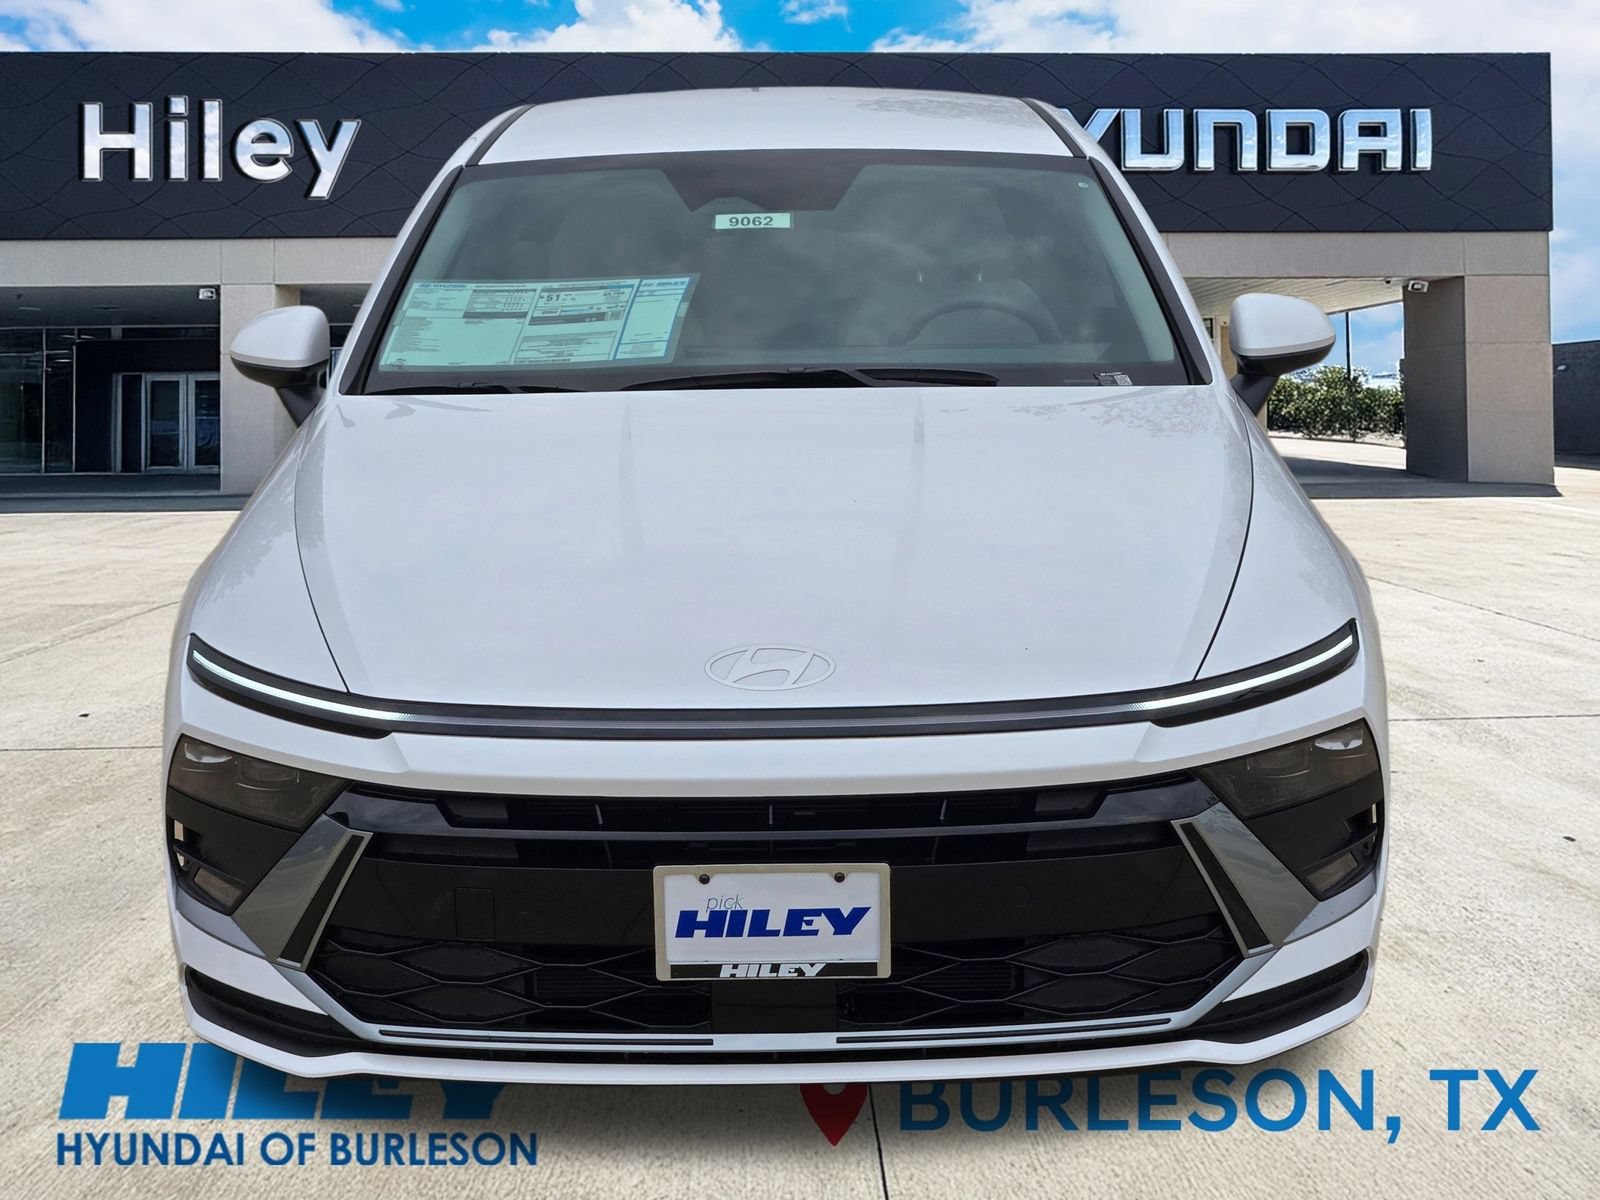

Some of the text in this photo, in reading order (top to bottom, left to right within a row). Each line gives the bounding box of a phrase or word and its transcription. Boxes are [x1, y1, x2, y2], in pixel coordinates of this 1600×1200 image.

[80, 95, 361, 199] Hiley
[728, 215, 774, 227] 9062
[706, 894, 745, 913] pick
[675, 907, 872, 938] HILEY
[719, 962, 827, 978] HILEY
